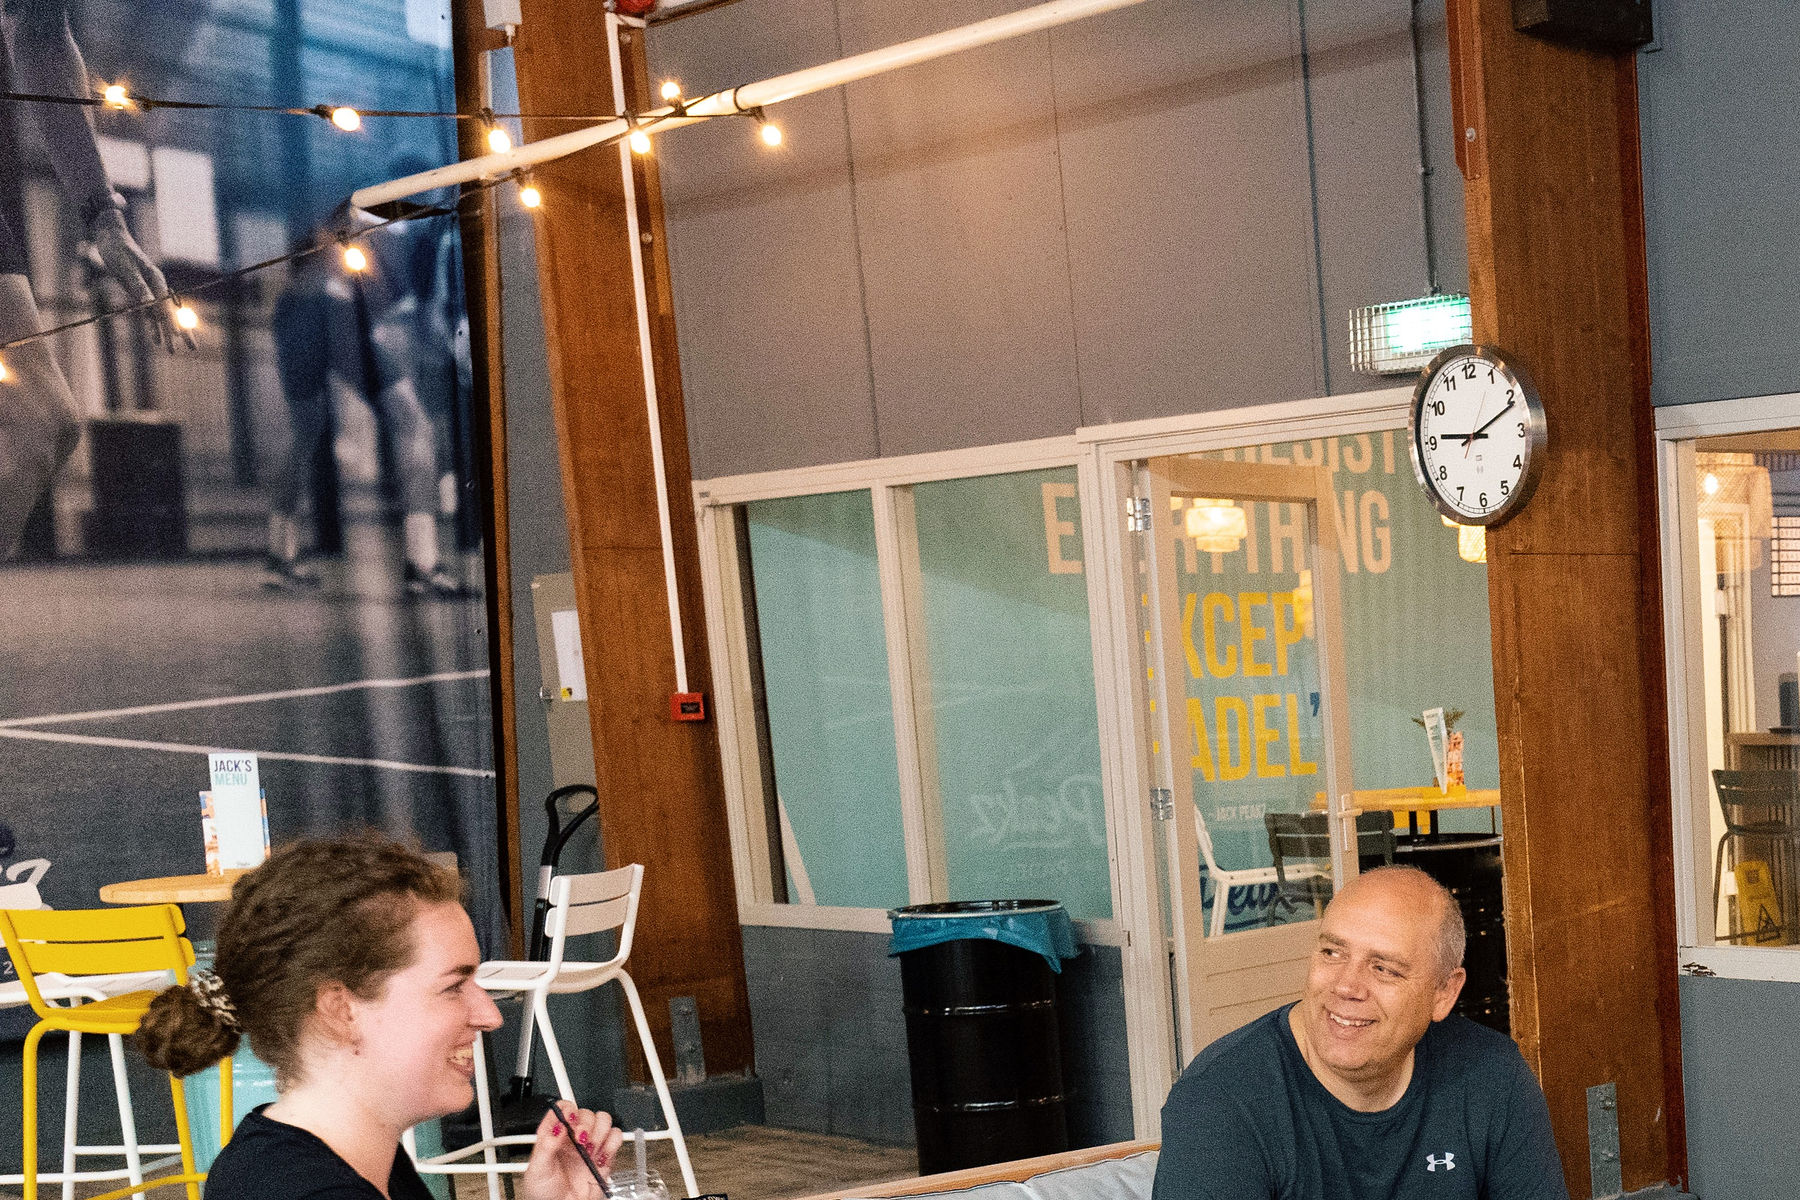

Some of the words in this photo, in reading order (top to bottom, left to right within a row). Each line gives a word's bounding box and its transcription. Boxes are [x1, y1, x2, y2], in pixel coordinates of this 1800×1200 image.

[1462, 364, 1476, 380] 12
[1488, 369, 1495, 385] 1
[1443, 376, 1456, 391] 11
[1506, 389, 1515, 405] 2
[1431, 400, 1445, 416] 10
[1517, 423, 1525, 438] 3
[1429, 435, 1437, 451] 9
[1513, 455, 1523, 470] 4
[1439, 466, 1447, 480] 8
[1456, 486, 1465, 502] 7
[1500, 480, 1509, 496] 5
[1479, 493, 1488, 508] 6
[1150, 691, 1321, 783] ADEL'
[214, 760, 252, 773] JACK'S
[214, 773, 248, 786] MENU
